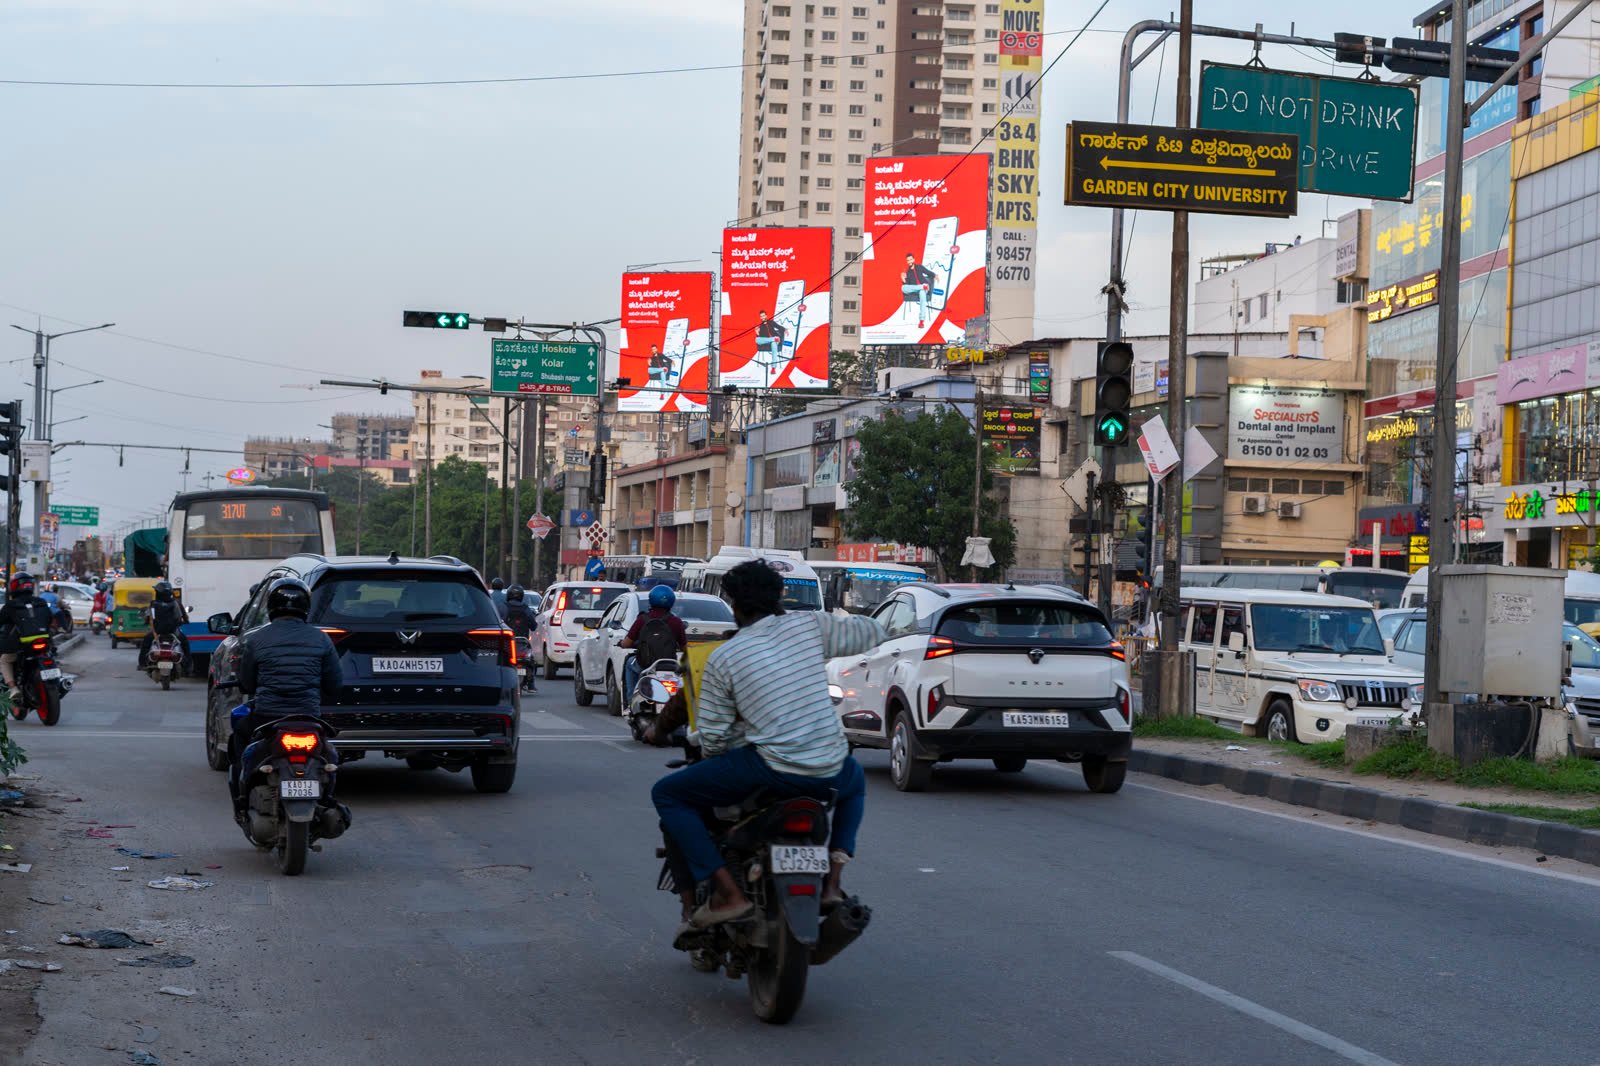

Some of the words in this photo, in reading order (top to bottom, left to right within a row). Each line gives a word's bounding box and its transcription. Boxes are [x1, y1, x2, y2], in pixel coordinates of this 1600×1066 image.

[1003, 10, 1040, 32] MOVE
[1212, 87, 1248, 113] DO
[1260, 94, 1314, 120] NOT
[1322, 99, 1404, 131] DRINK
[998, 149, 1035, 169] BHK
[1155, 136, 1183, 153] ಸಿಟಿ
[1190, 138, 1292, 169] ವಿಶ್ವವಿದ್ಯಾಲಯ
[1302, 145, 1379, 174] DRIVE
[997, 174, 1035, 194] SKY
[1083, 178, 1148, 197] GARDEN
[1152, 182, 1189, 199] CITY
[1193, 185, 1287, 205] UNIVERSITY
[996, 201, 1034, 222] APTS.
[996, 245, 1032, 261] 98457
[996, 266, 1030, 281] 66770
[541, 344, 577, 354] Hoskote
[946, 347, 984, 363] GYM
[541, 358, 565, 368] Kolar
[546, 385, 571, 393] B-TRAC
[1238, 421, 1271, 432] Dental
[1274, 422, 1293, 432] and
[1297, 423, 1336, 435] Implant
[1242, 445, 1272, 456] 8150
[1276, 447, 1290, 457] 01
[1295, 447, 1309, 458] 02
[1313, 447, 1328, 459] 03
[379, 660, 442, 671] KA04NH5157
[1010, 714, 1068, 726] KA53MN6152
[784, 847, 816, 860] AP03
[780, 859, 828, 871] CJ2798
